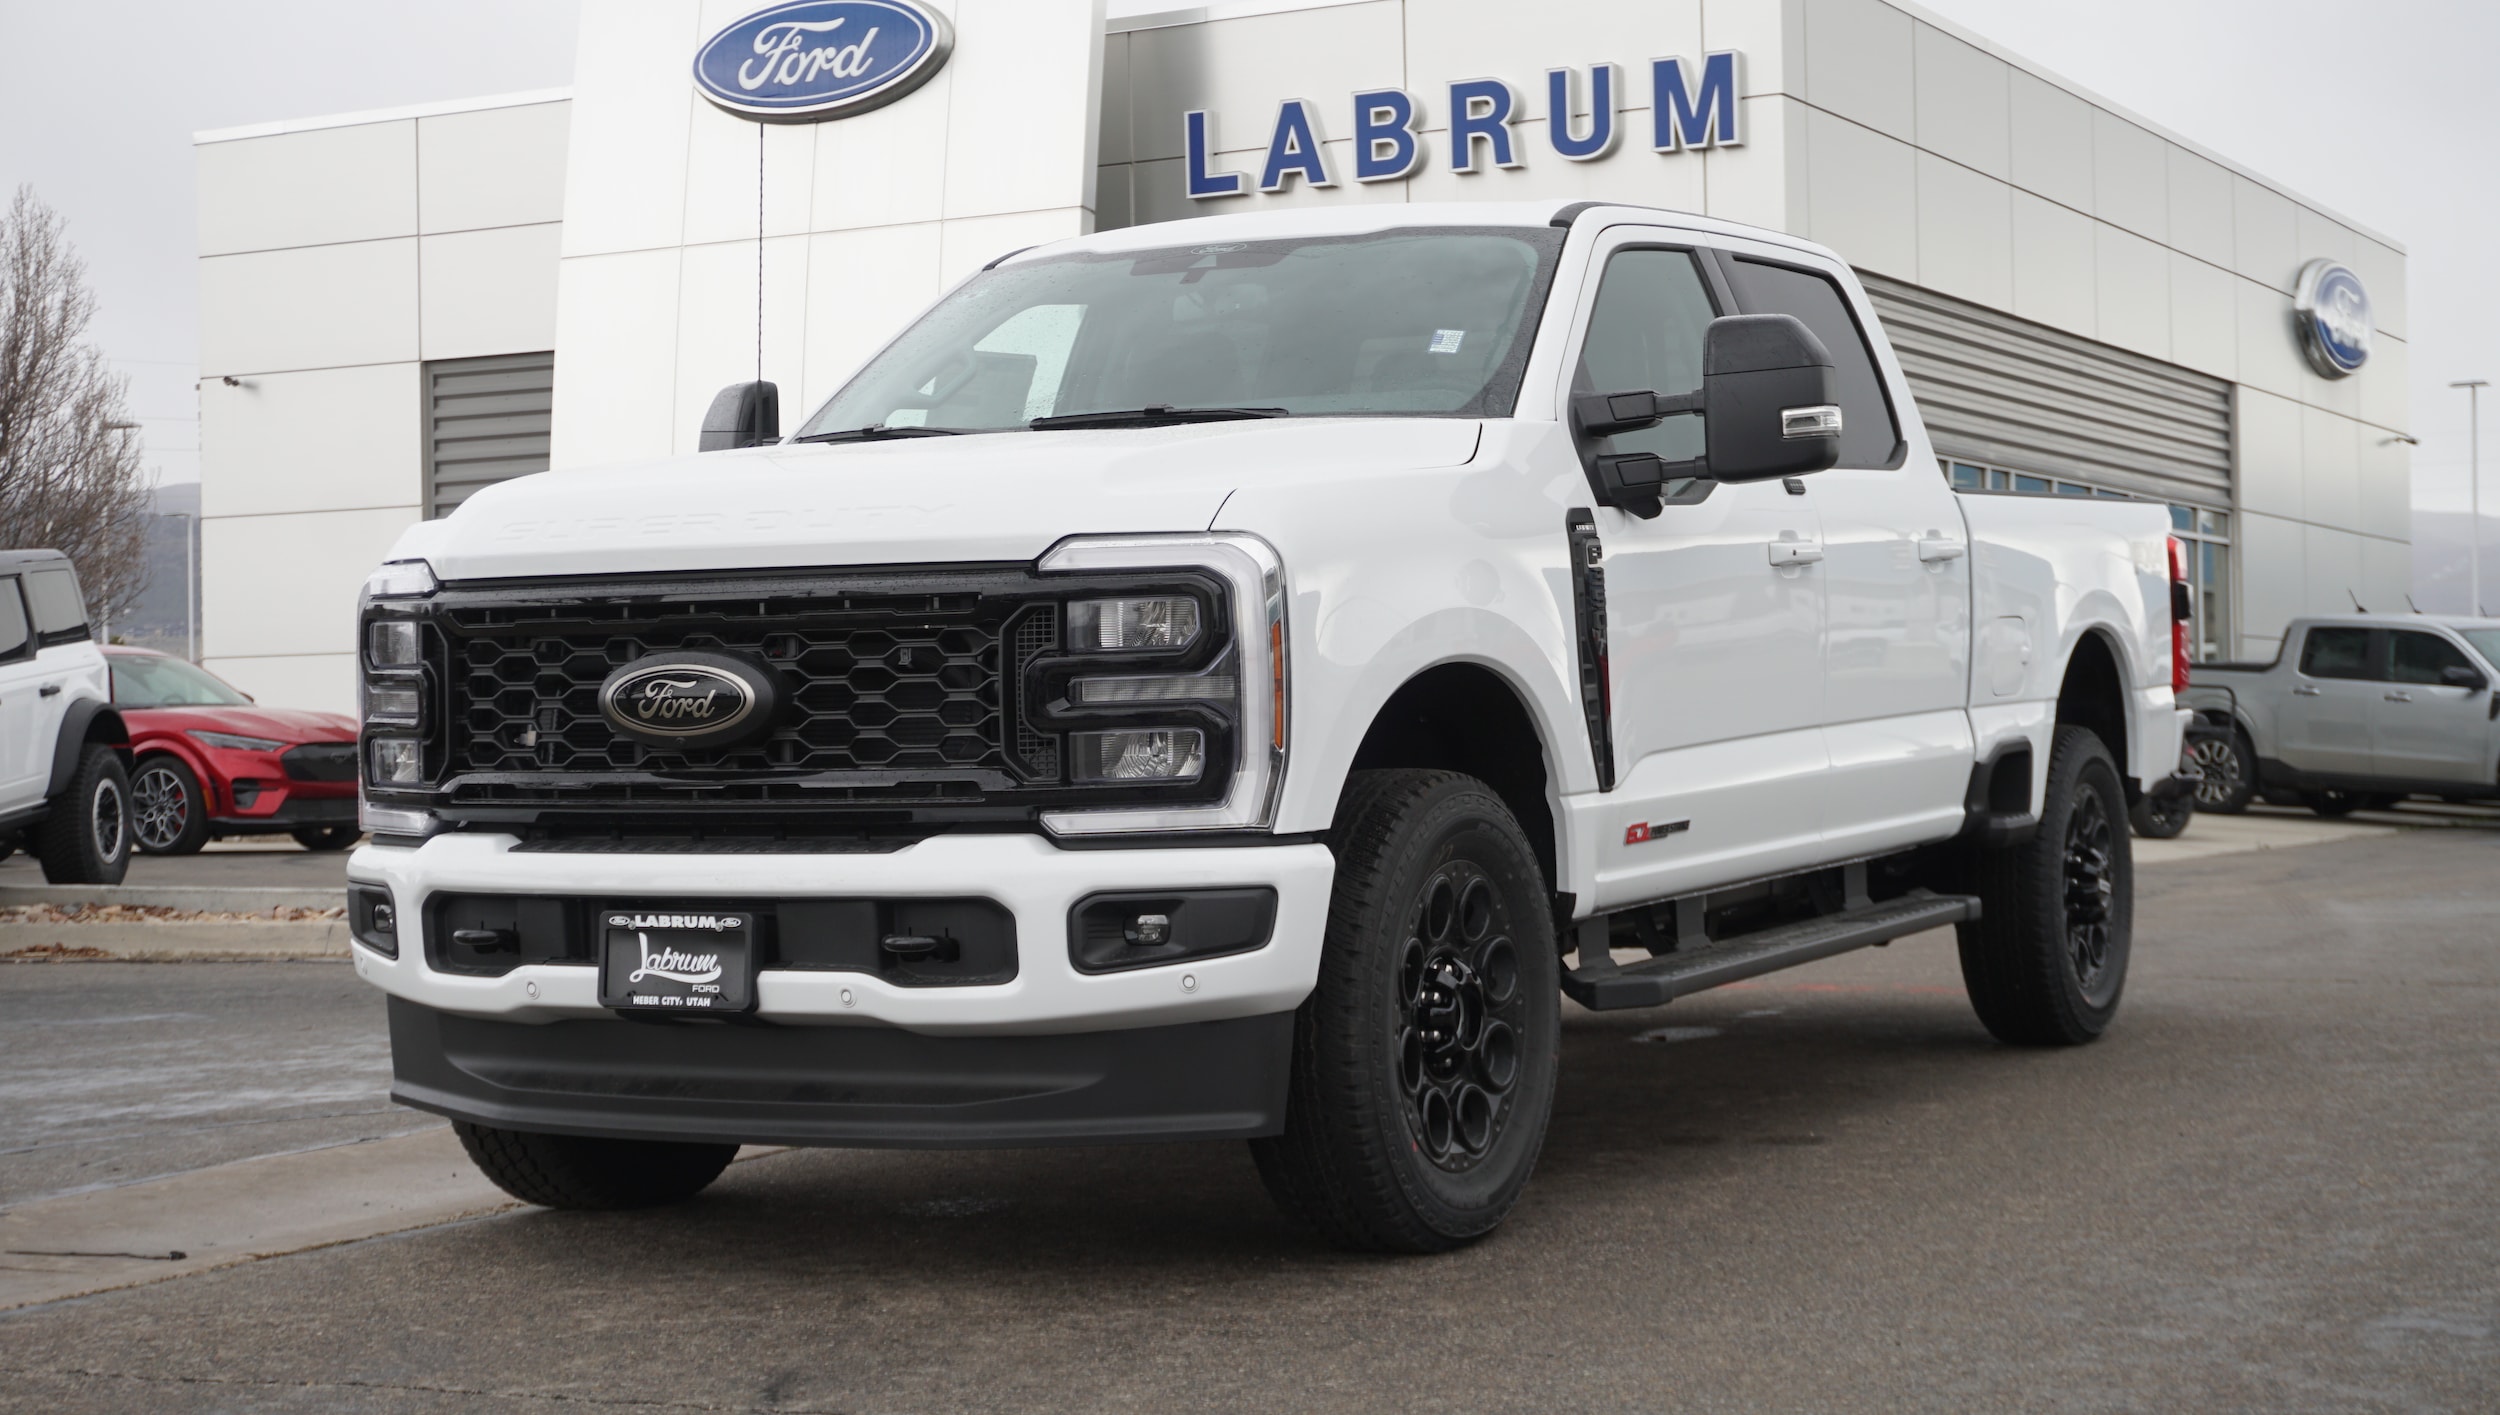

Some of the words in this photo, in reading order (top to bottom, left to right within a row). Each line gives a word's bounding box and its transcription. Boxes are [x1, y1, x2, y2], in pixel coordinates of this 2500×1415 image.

[738, 17, 879, 90] Ford
[1184, 49, 1745, 198] LABRUM
[637, 679, 717, 718] Ford
[635, 914, 717, 928] LABRUM
[629, 932, 722, 984] Labrum
[632, 995, 660, 1006] HEBER
[686, 997, 711, 1007] UTAH
[692, 984, 720, 993] FORD
